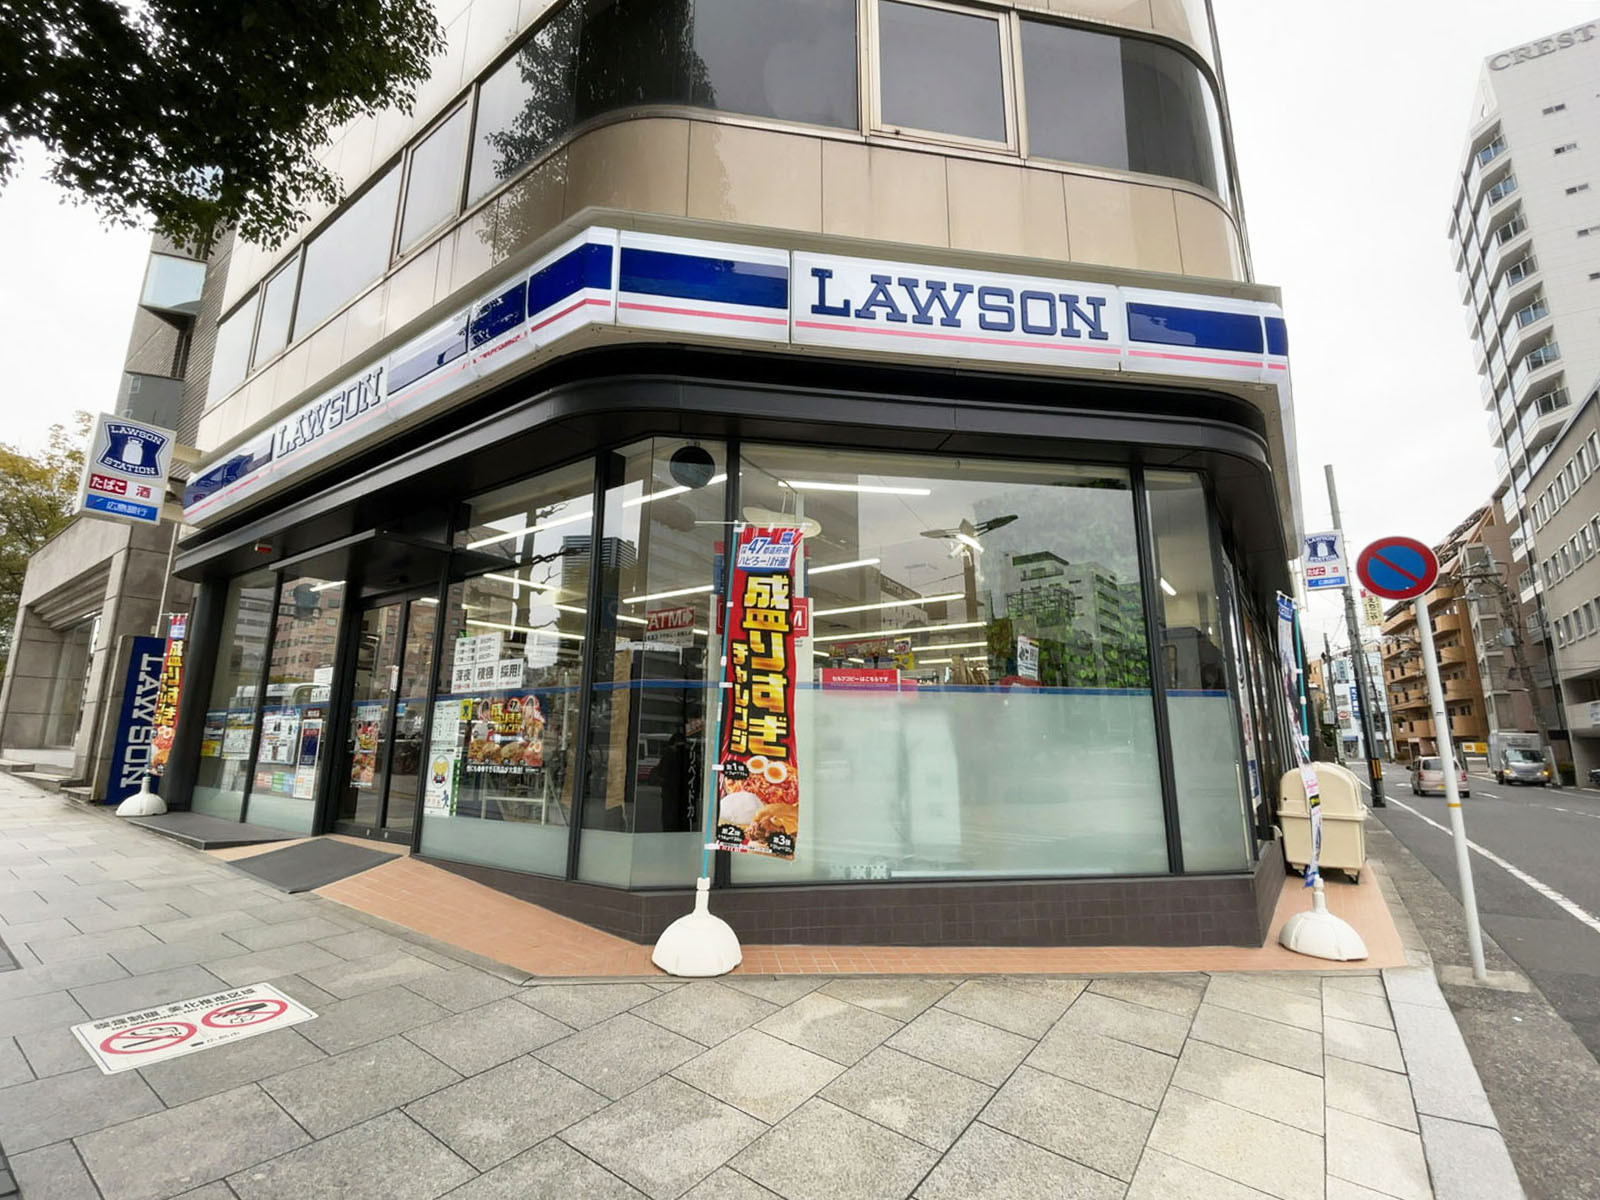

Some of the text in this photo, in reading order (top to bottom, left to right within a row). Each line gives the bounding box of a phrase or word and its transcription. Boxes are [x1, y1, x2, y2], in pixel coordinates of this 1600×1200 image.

[1489, 24, 1596, 71] CREST
[811, 267, 1109, 340] LAWSON
[110, 425, 163, 445] LAWSON
[276, 366, 384, 458] LAWSON
[91, 476, 151, 499] たばこ 酒
[104, 456, 156, 474] STATION
[648, 610, 682, 630] ATM
[743, 574, 789, 757] 盛りすぎ
[120, 653, 163, 788] LAWSON
[730, 642, 749, 754] チャレンジ
